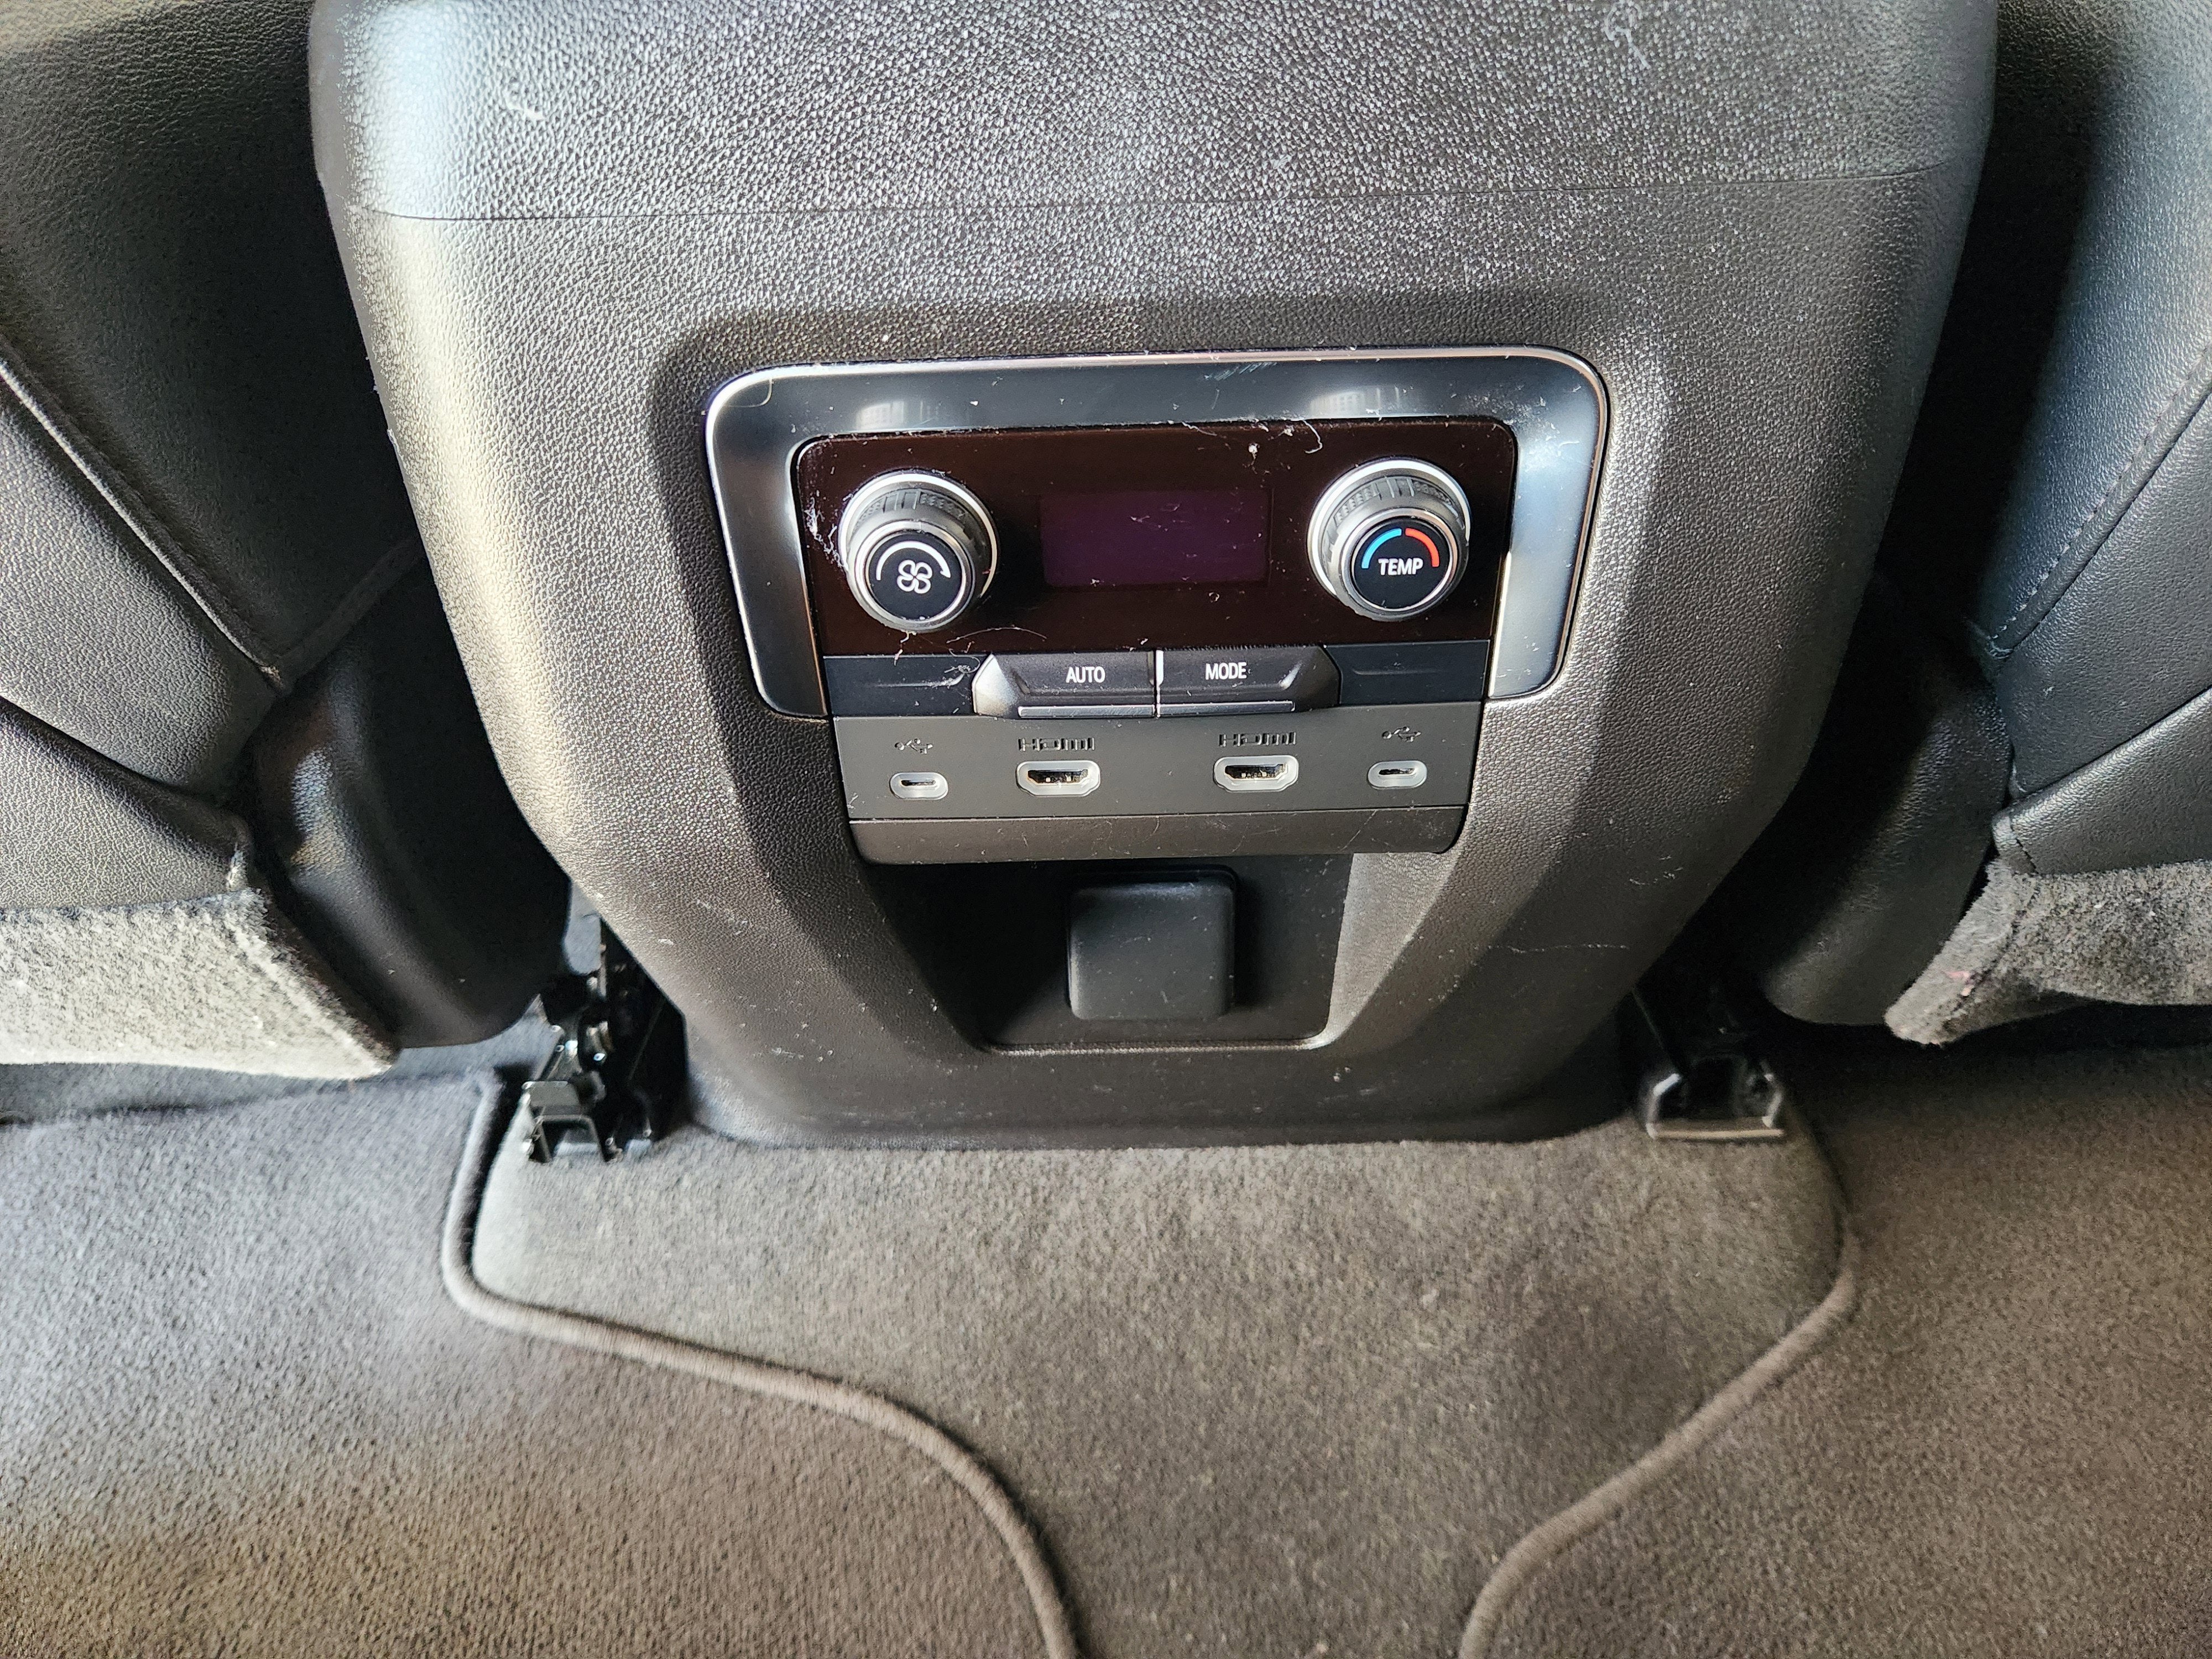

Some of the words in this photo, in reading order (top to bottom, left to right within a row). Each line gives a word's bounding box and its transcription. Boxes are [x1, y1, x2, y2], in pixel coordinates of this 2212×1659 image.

[1378, 557, 1423, 575] TEMP
[1066, 666, 1105, 683] AUTO
[1206, 661, 1247, 680] MODE
